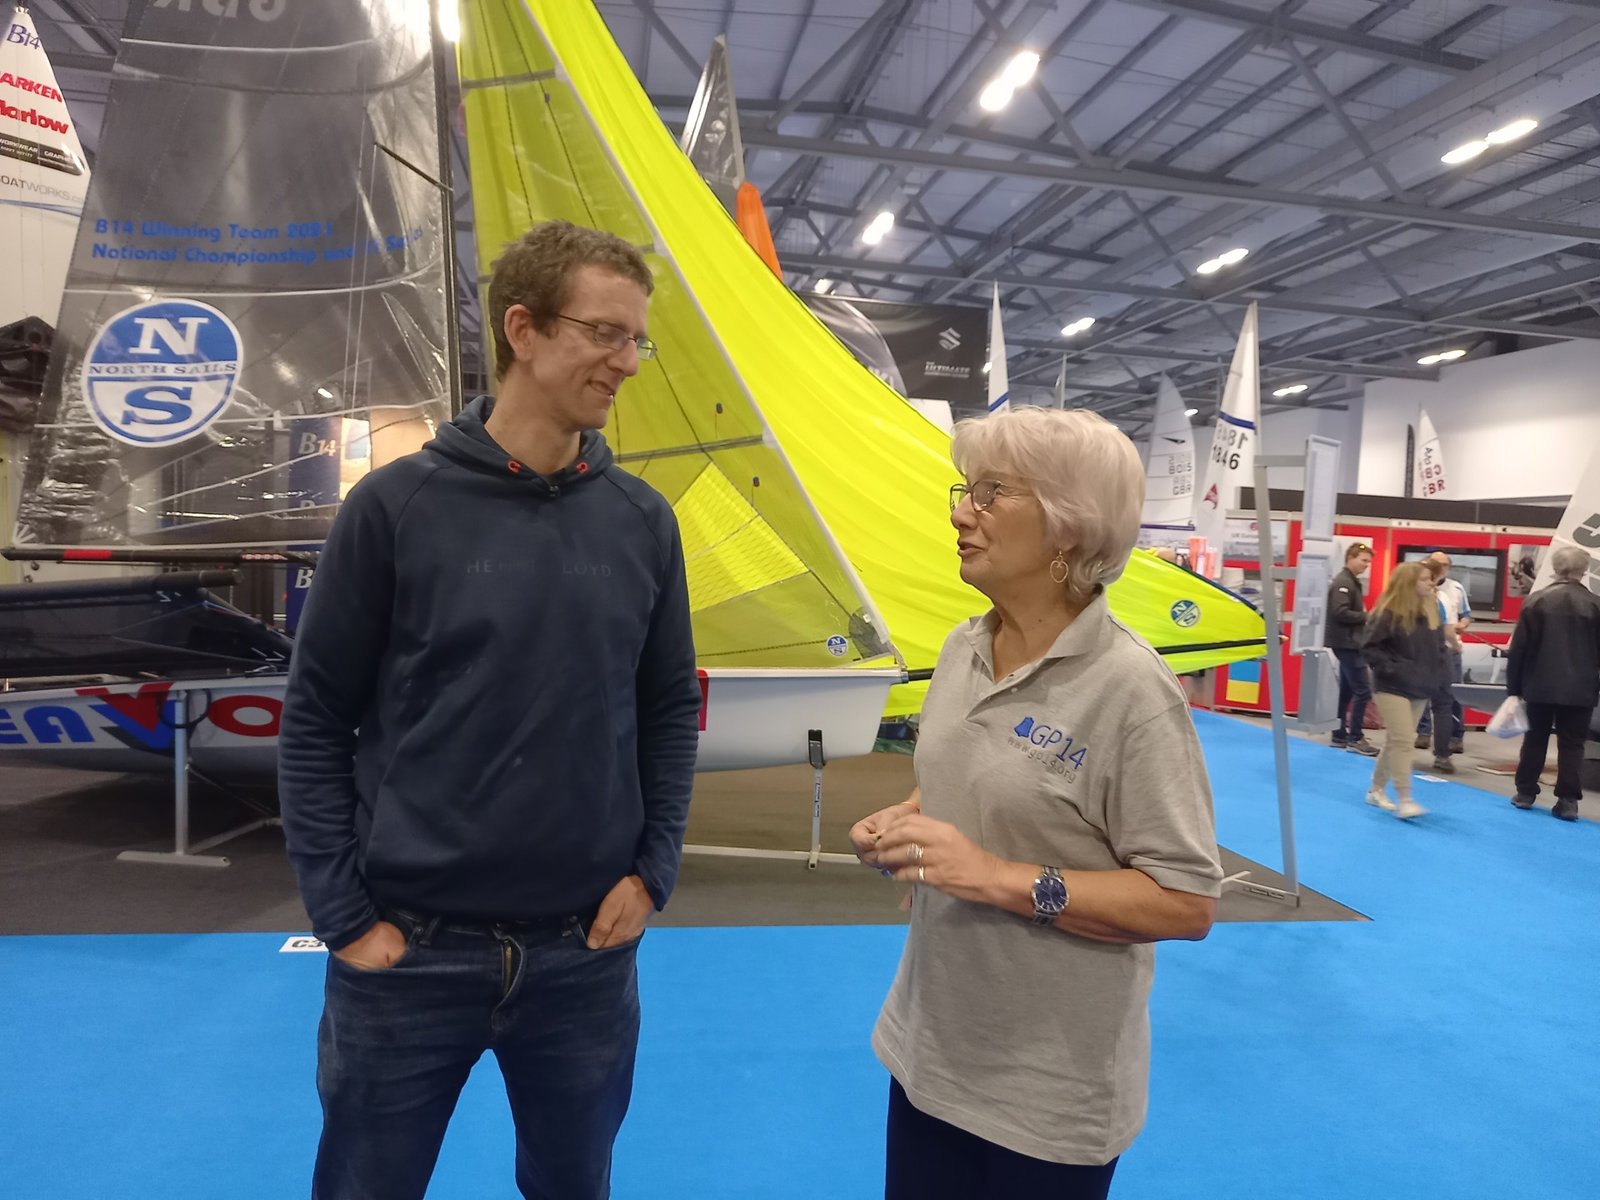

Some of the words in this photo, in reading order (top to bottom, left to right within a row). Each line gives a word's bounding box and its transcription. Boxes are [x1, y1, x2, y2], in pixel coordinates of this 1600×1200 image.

[6, 23, 41, 50] B14
[0, 72, 63, 103] ARKEN
[140, 220, 222, 243] Winning
[227, 223, 279, 240] Team
[92, 242, 178, 262] National
[183, 245, 317, 267] Championship
[128, 316, 209, 356] N
[88, 364, 165, 376] NORTH
[173, 361, 237, 376] SAILS
[120, 385, 193, 426] S
[298, 432, 336, 457] B14
[561, 560, 612, 578] LOYD
[1030, 724, 1088, 770] GP14
